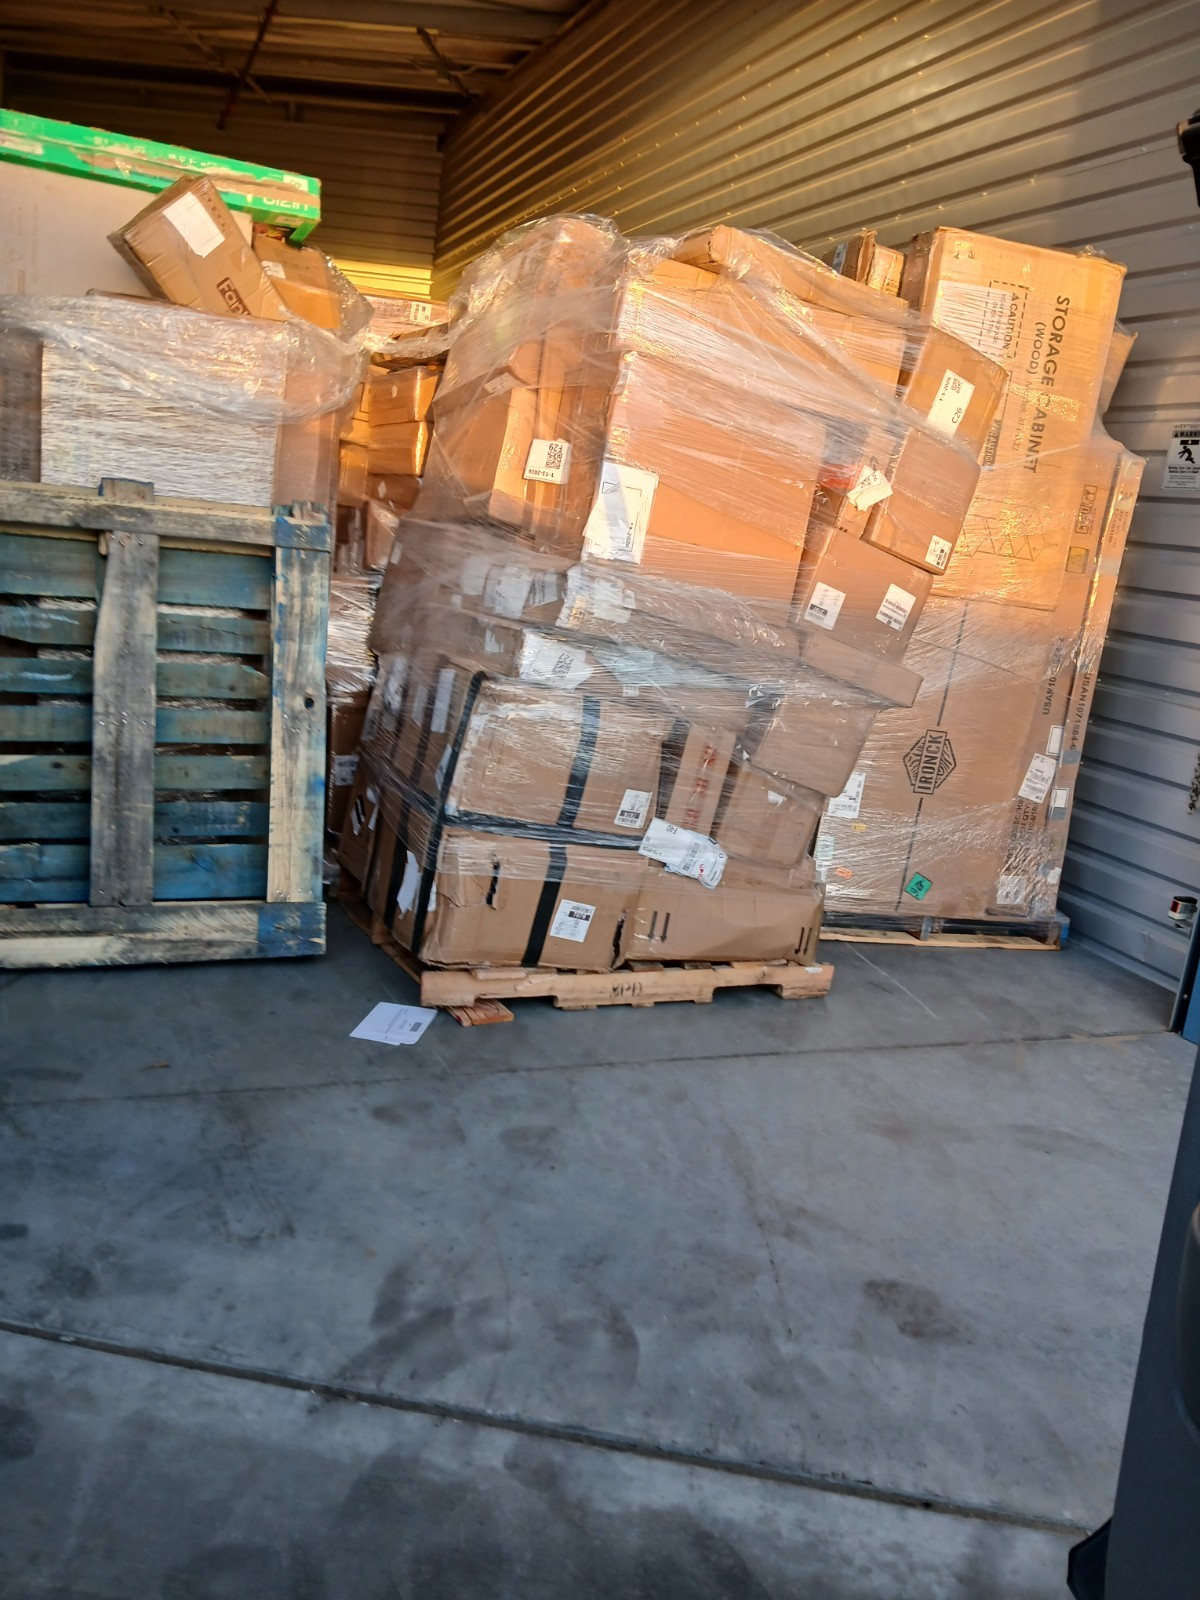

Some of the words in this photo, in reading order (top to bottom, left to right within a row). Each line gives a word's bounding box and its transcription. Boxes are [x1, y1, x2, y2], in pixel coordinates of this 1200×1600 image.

[1003, 304, 1017, 349] CAUTION
[1027, 322, 1046, 374] (WOOD)
[1041, 296, 1070, 386] STORAGE
[951, 407, 963, 423] C26
[1023, 394, 1051, 473] CABINET
[548, 443, 562, 452] F29
[918, 734, 943, 791] IRONCK
